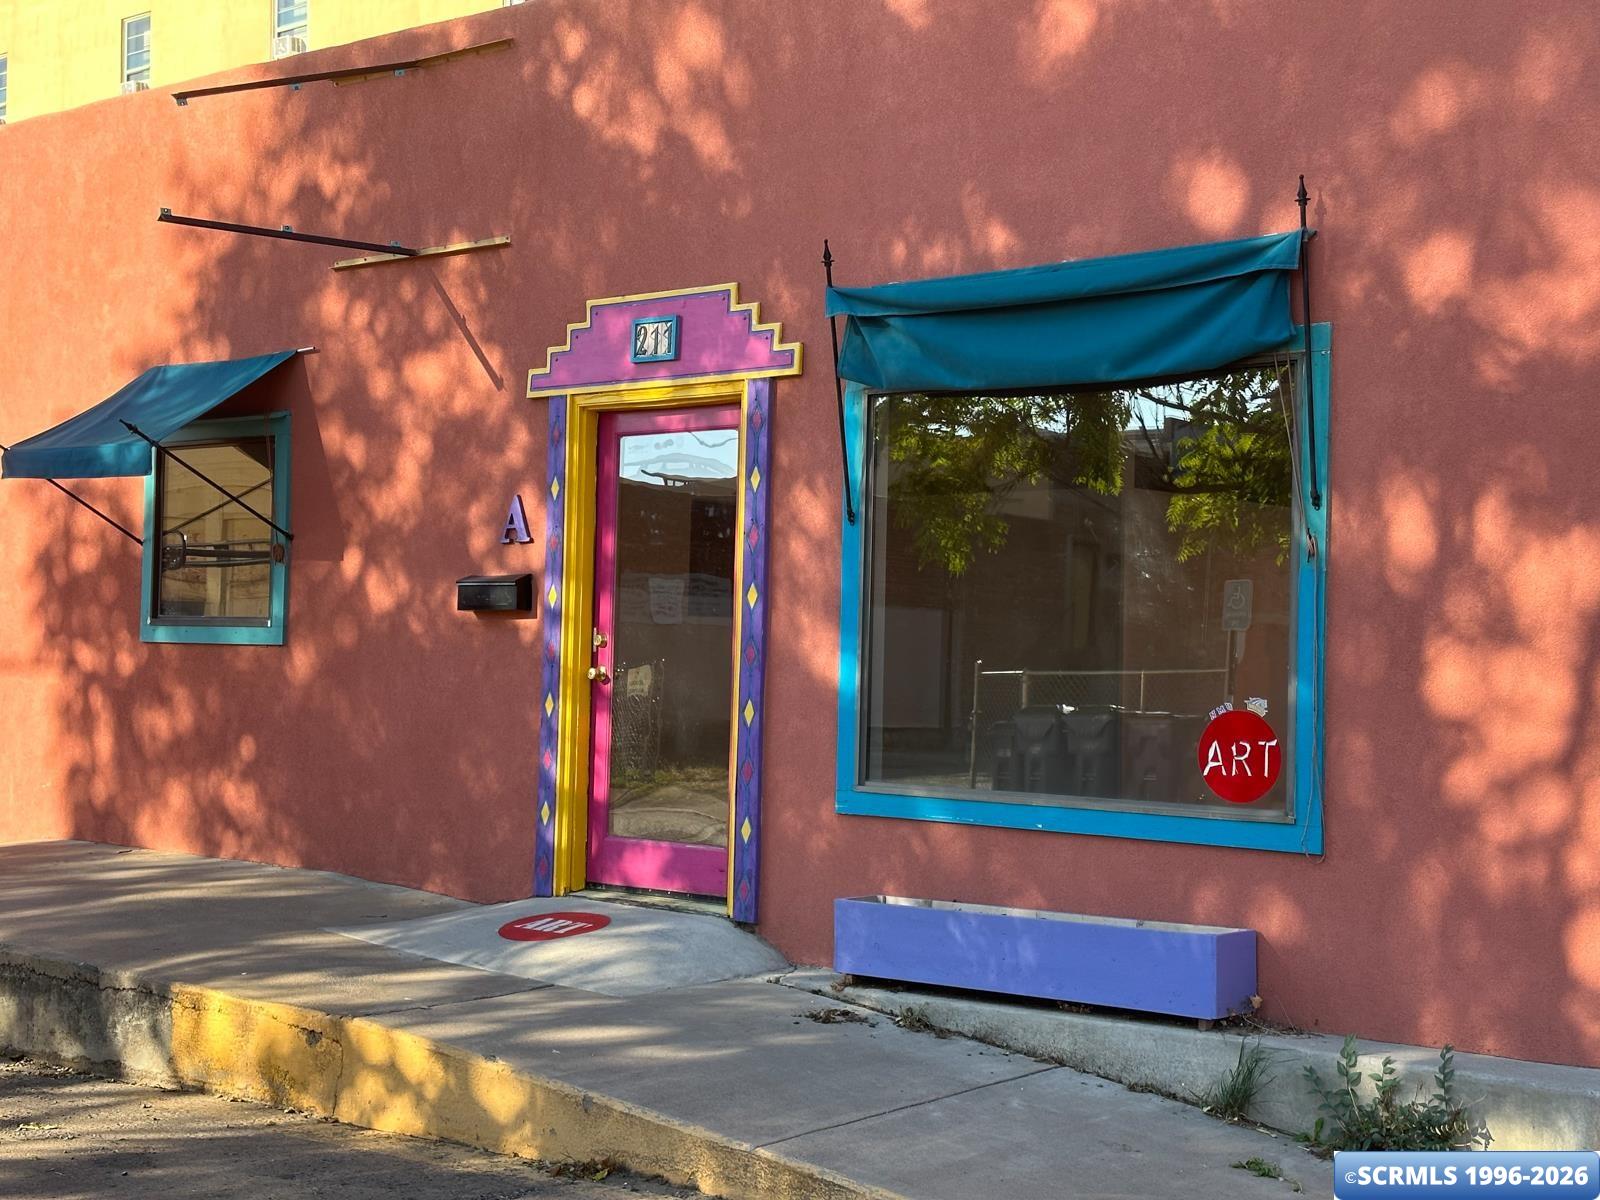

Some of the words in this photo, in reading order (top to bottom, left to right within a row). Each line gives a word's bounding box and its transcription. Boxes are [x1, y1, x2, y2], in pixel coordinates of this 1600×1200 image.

[636, 321, 672, 355] 211
[500, 494, 533, 544] A
[1203, 739, 1278, 778] ART
[514, 918, 593, 933] ART
